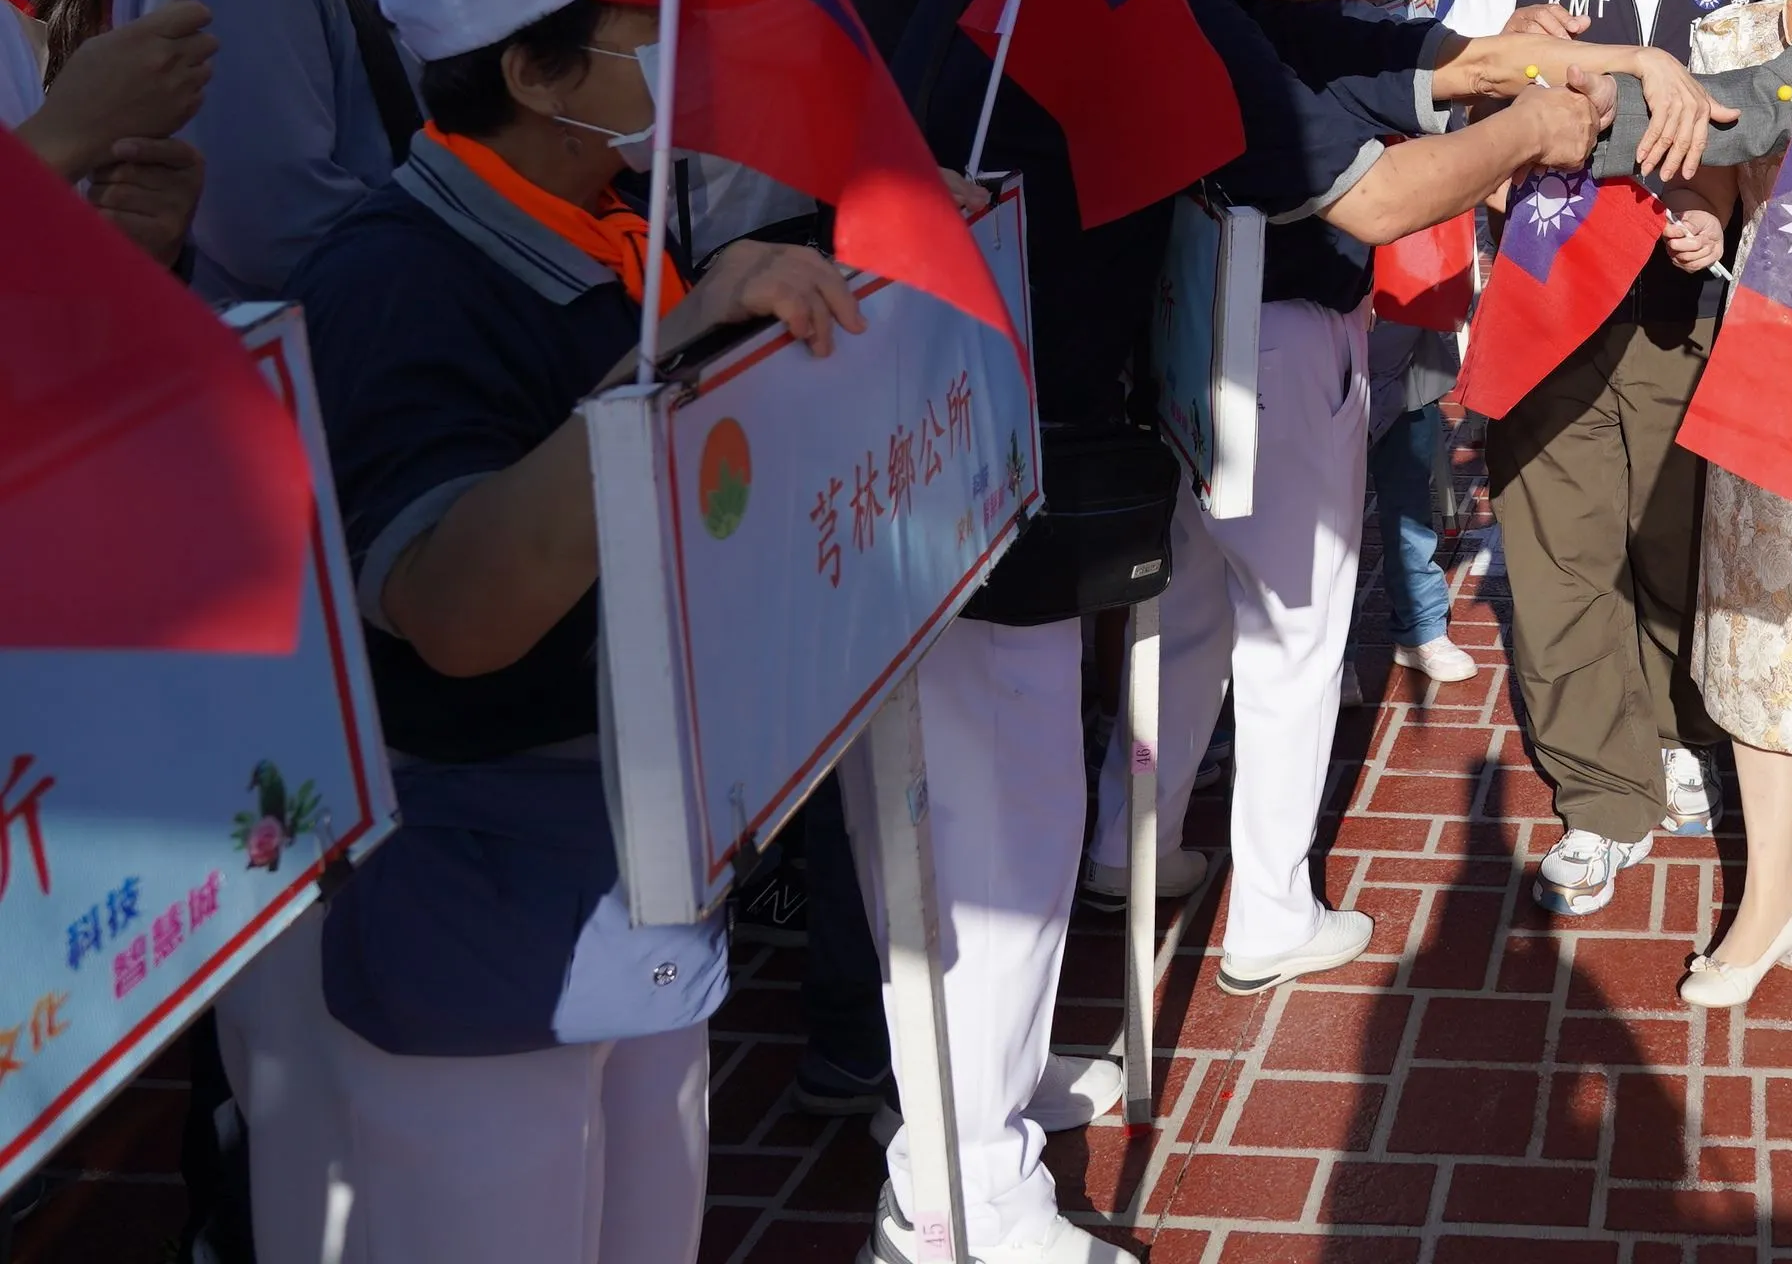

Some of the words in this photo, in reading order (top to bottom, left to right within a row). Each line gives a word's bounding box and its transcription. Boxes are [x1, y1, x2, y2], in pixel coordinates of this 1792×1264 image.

[809, 369, 972, 589] 芎林鄉公所
[65, 875, 142, 971] 科技
[112, 868, 222, 1000] 智慧城
